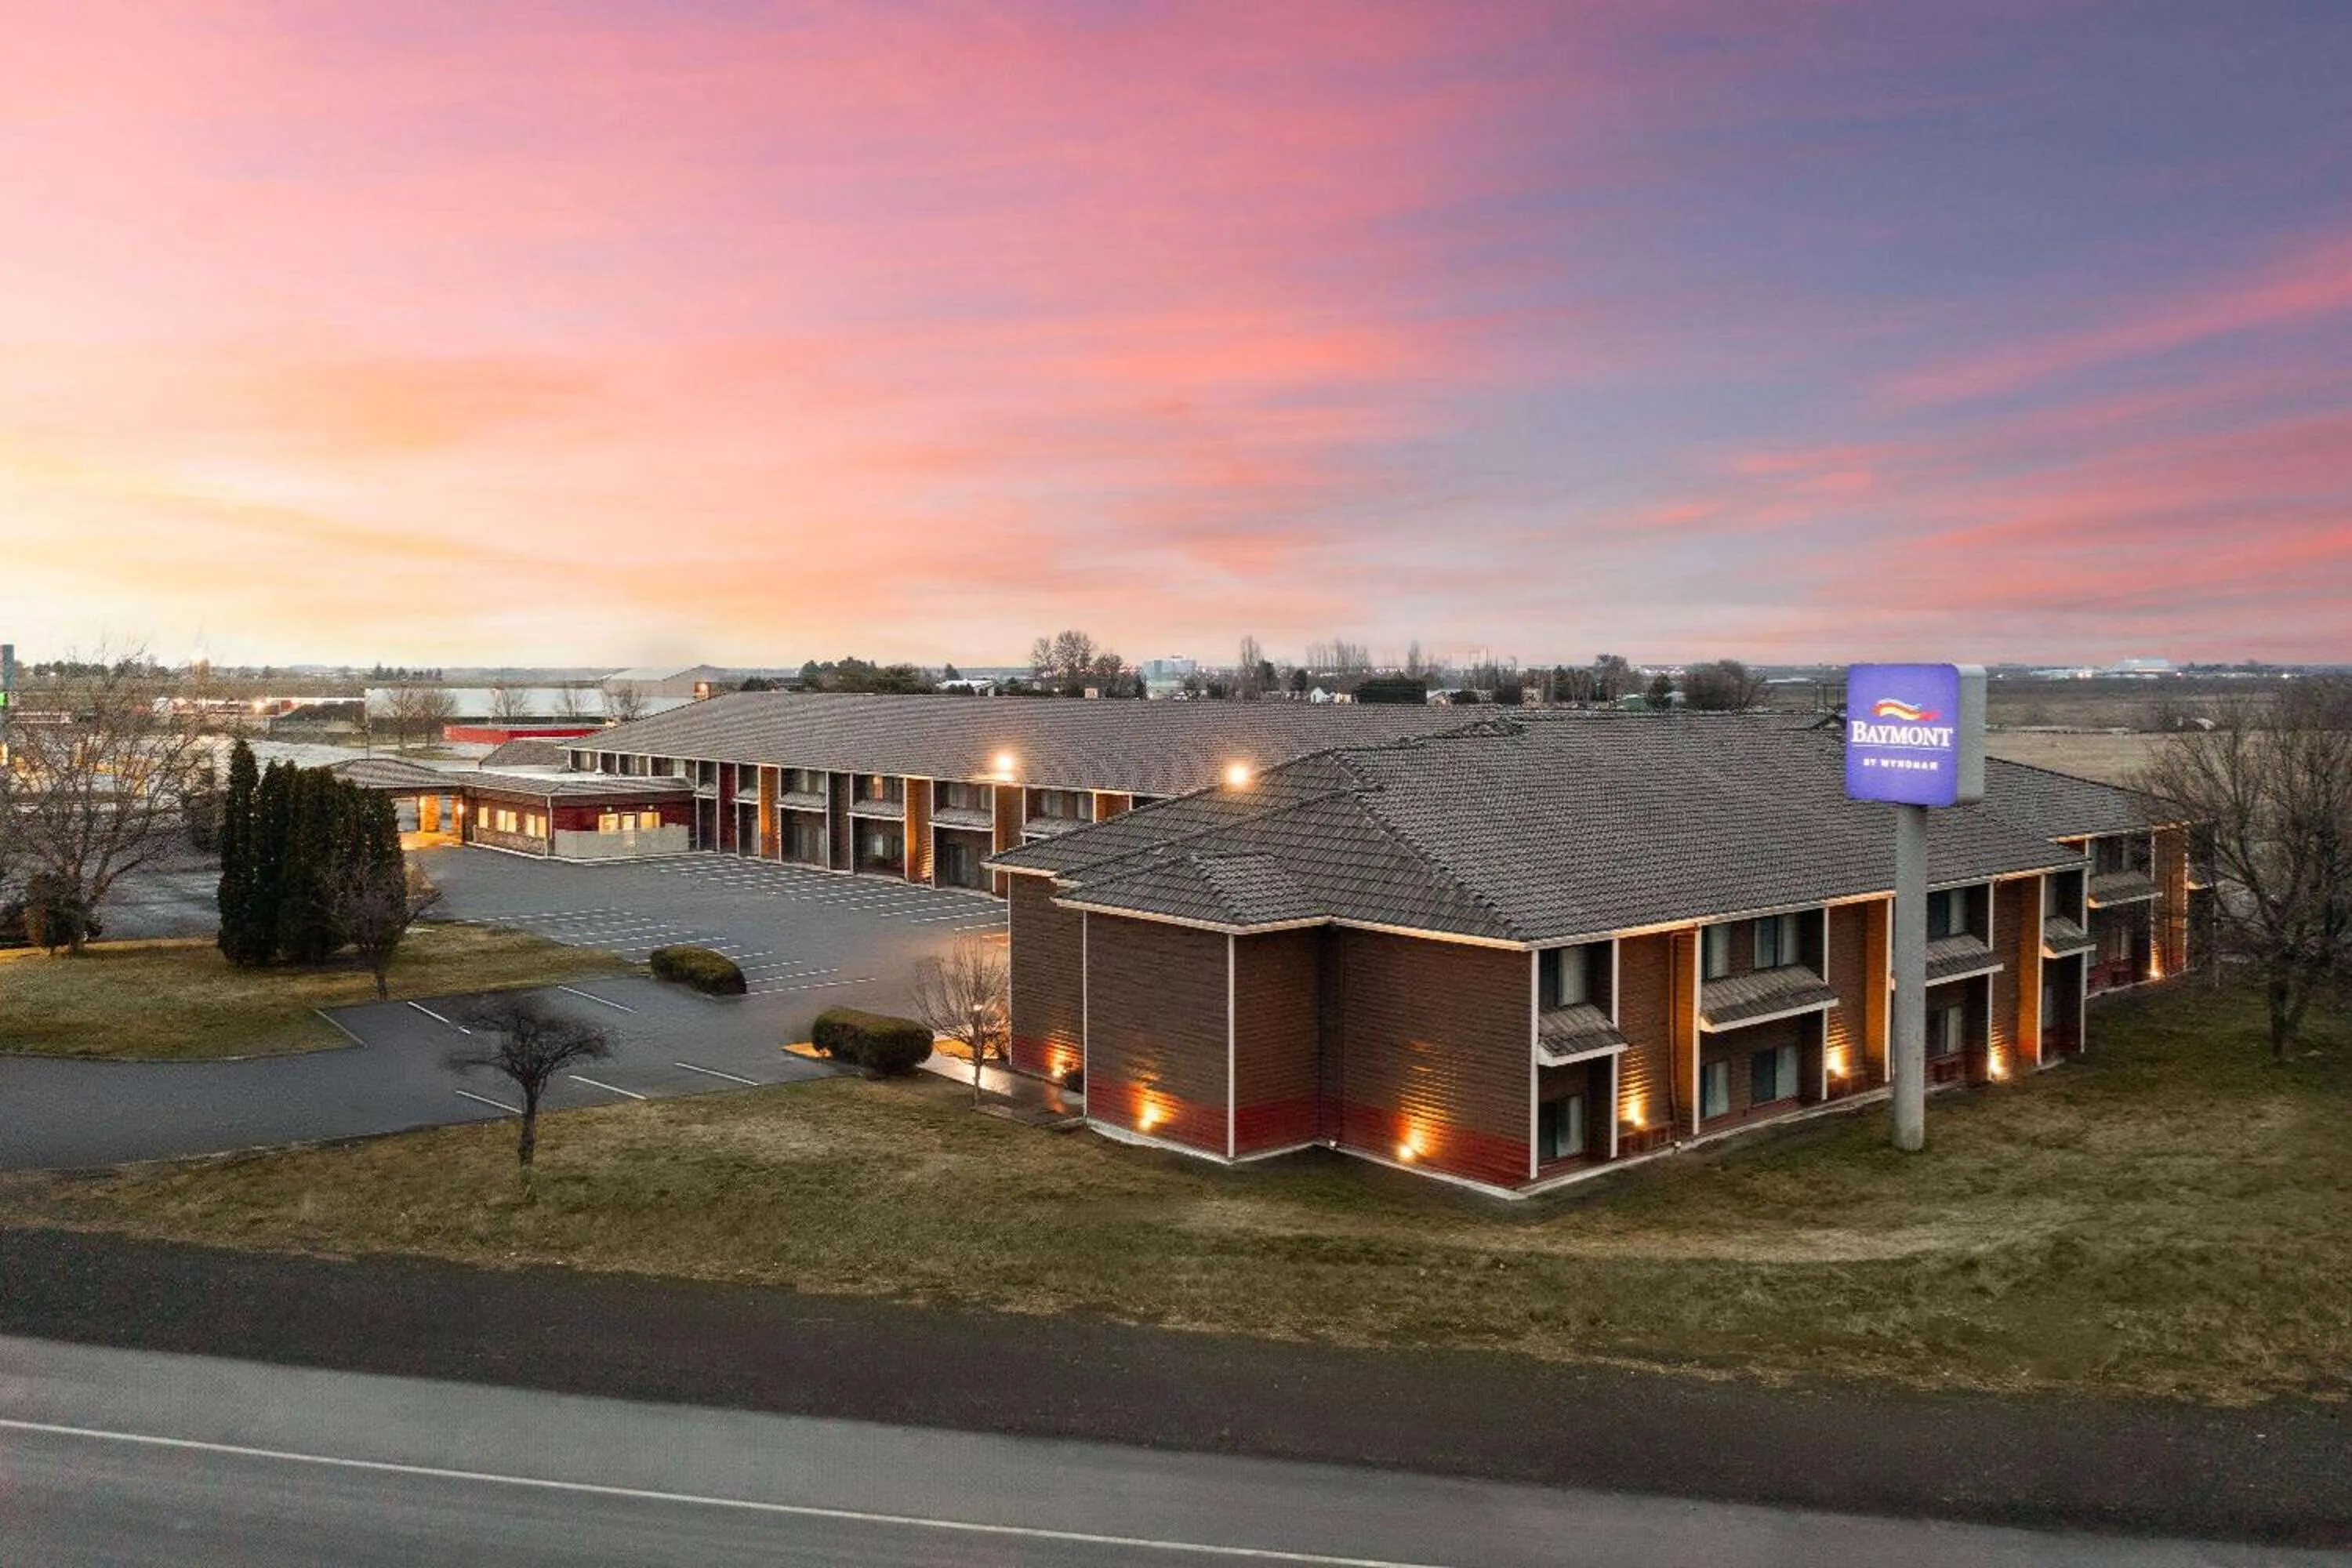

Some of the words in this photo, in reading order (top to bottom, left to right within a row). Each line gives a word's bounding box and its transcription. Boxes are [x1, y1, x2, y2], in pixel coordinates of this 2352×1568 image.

[1851, 720, 1954, 747] BAYMONT
[1863, 758, 1877, 767] BY
[1881, 758, 1939, 771] WYNDHAM
